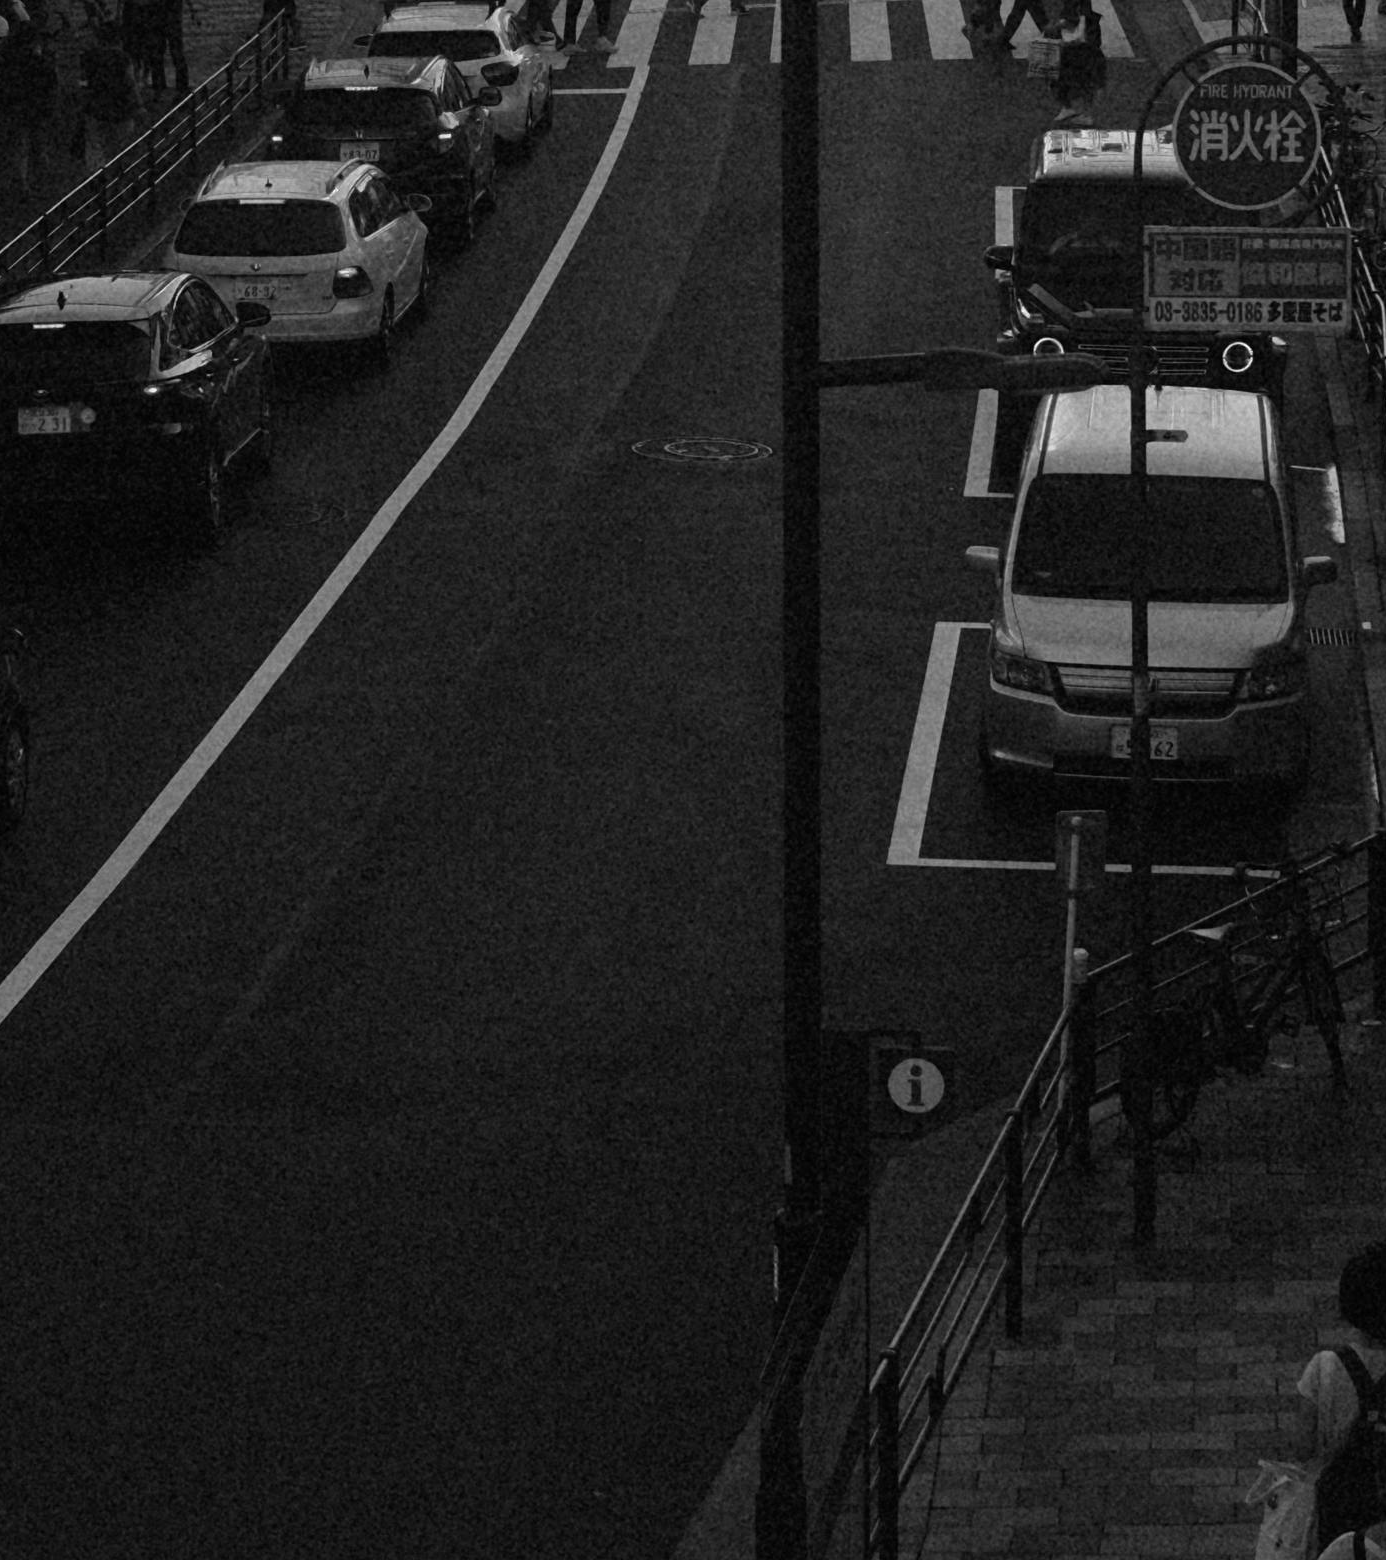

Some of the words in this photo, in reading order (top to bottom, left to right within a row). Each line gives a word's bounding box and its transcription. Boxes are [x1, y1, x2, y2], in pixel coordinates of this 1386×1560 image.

[1199, 83, 1229, 99] FIRE
[1232, 83, 1294, 99] HYDRANT
[1189, 108, 1308, 163] 消火栓
[1155, 300, 1263, 323] 03-3835-0186
